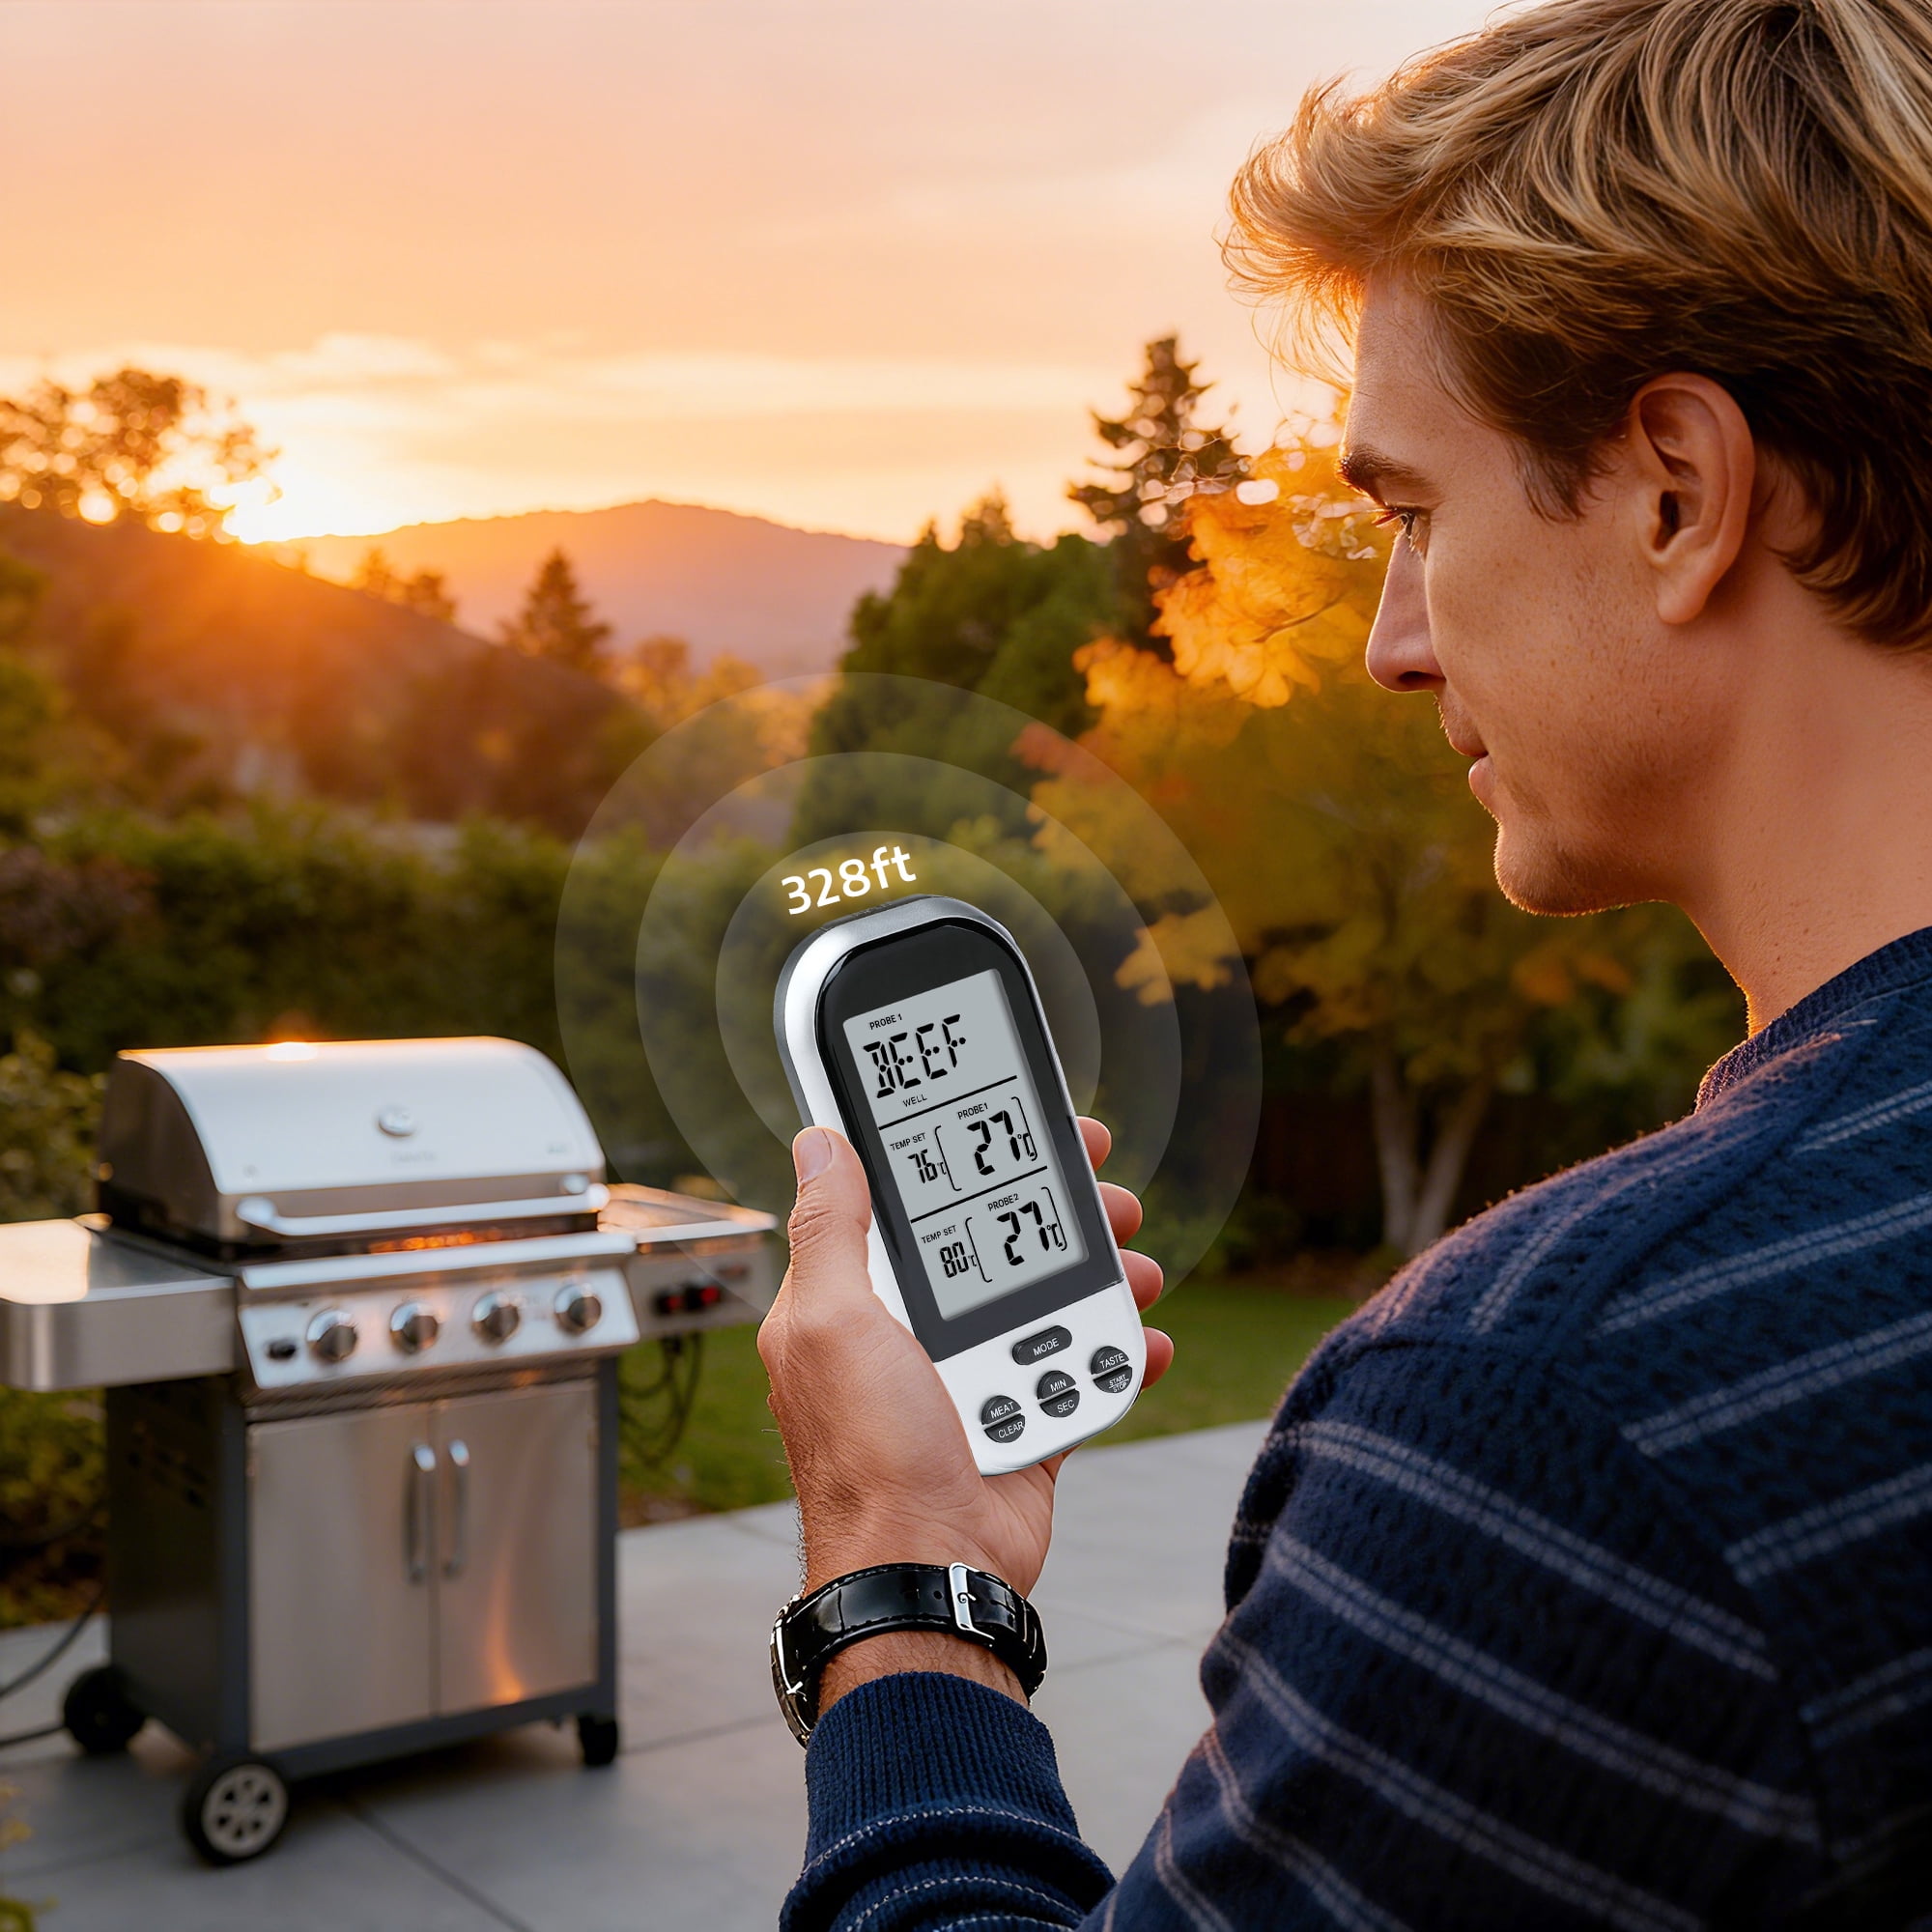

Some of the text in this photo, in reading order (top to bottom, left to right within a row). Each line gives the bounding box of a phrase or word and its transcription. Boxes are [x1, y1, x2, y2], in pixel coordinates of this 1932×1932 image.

[869, 1014, 896, 1030] PROBE
[863, 1013, 966, 1098] BEEF
[902, 1094, 927, 1107] WELL
[890, 1132, 926, 1151] TEMP SET
[922, 1225, 957, 1244] TEMP SET
[1033, 1338, 1060, 1355] MODE
[1099, 1352, 1125, 1369] TASTE
[1050, 1378, 1066, 1392] MIN
[1109, 1375, 1126, 1385] START
[1113, 1382, 1127, 1393] STOP
[990, 1402, 1014, 1419] MEAT
[1057, 1400, 1075, 1413] SEC
[998, 1421, 1024, 1438] CLEAR
